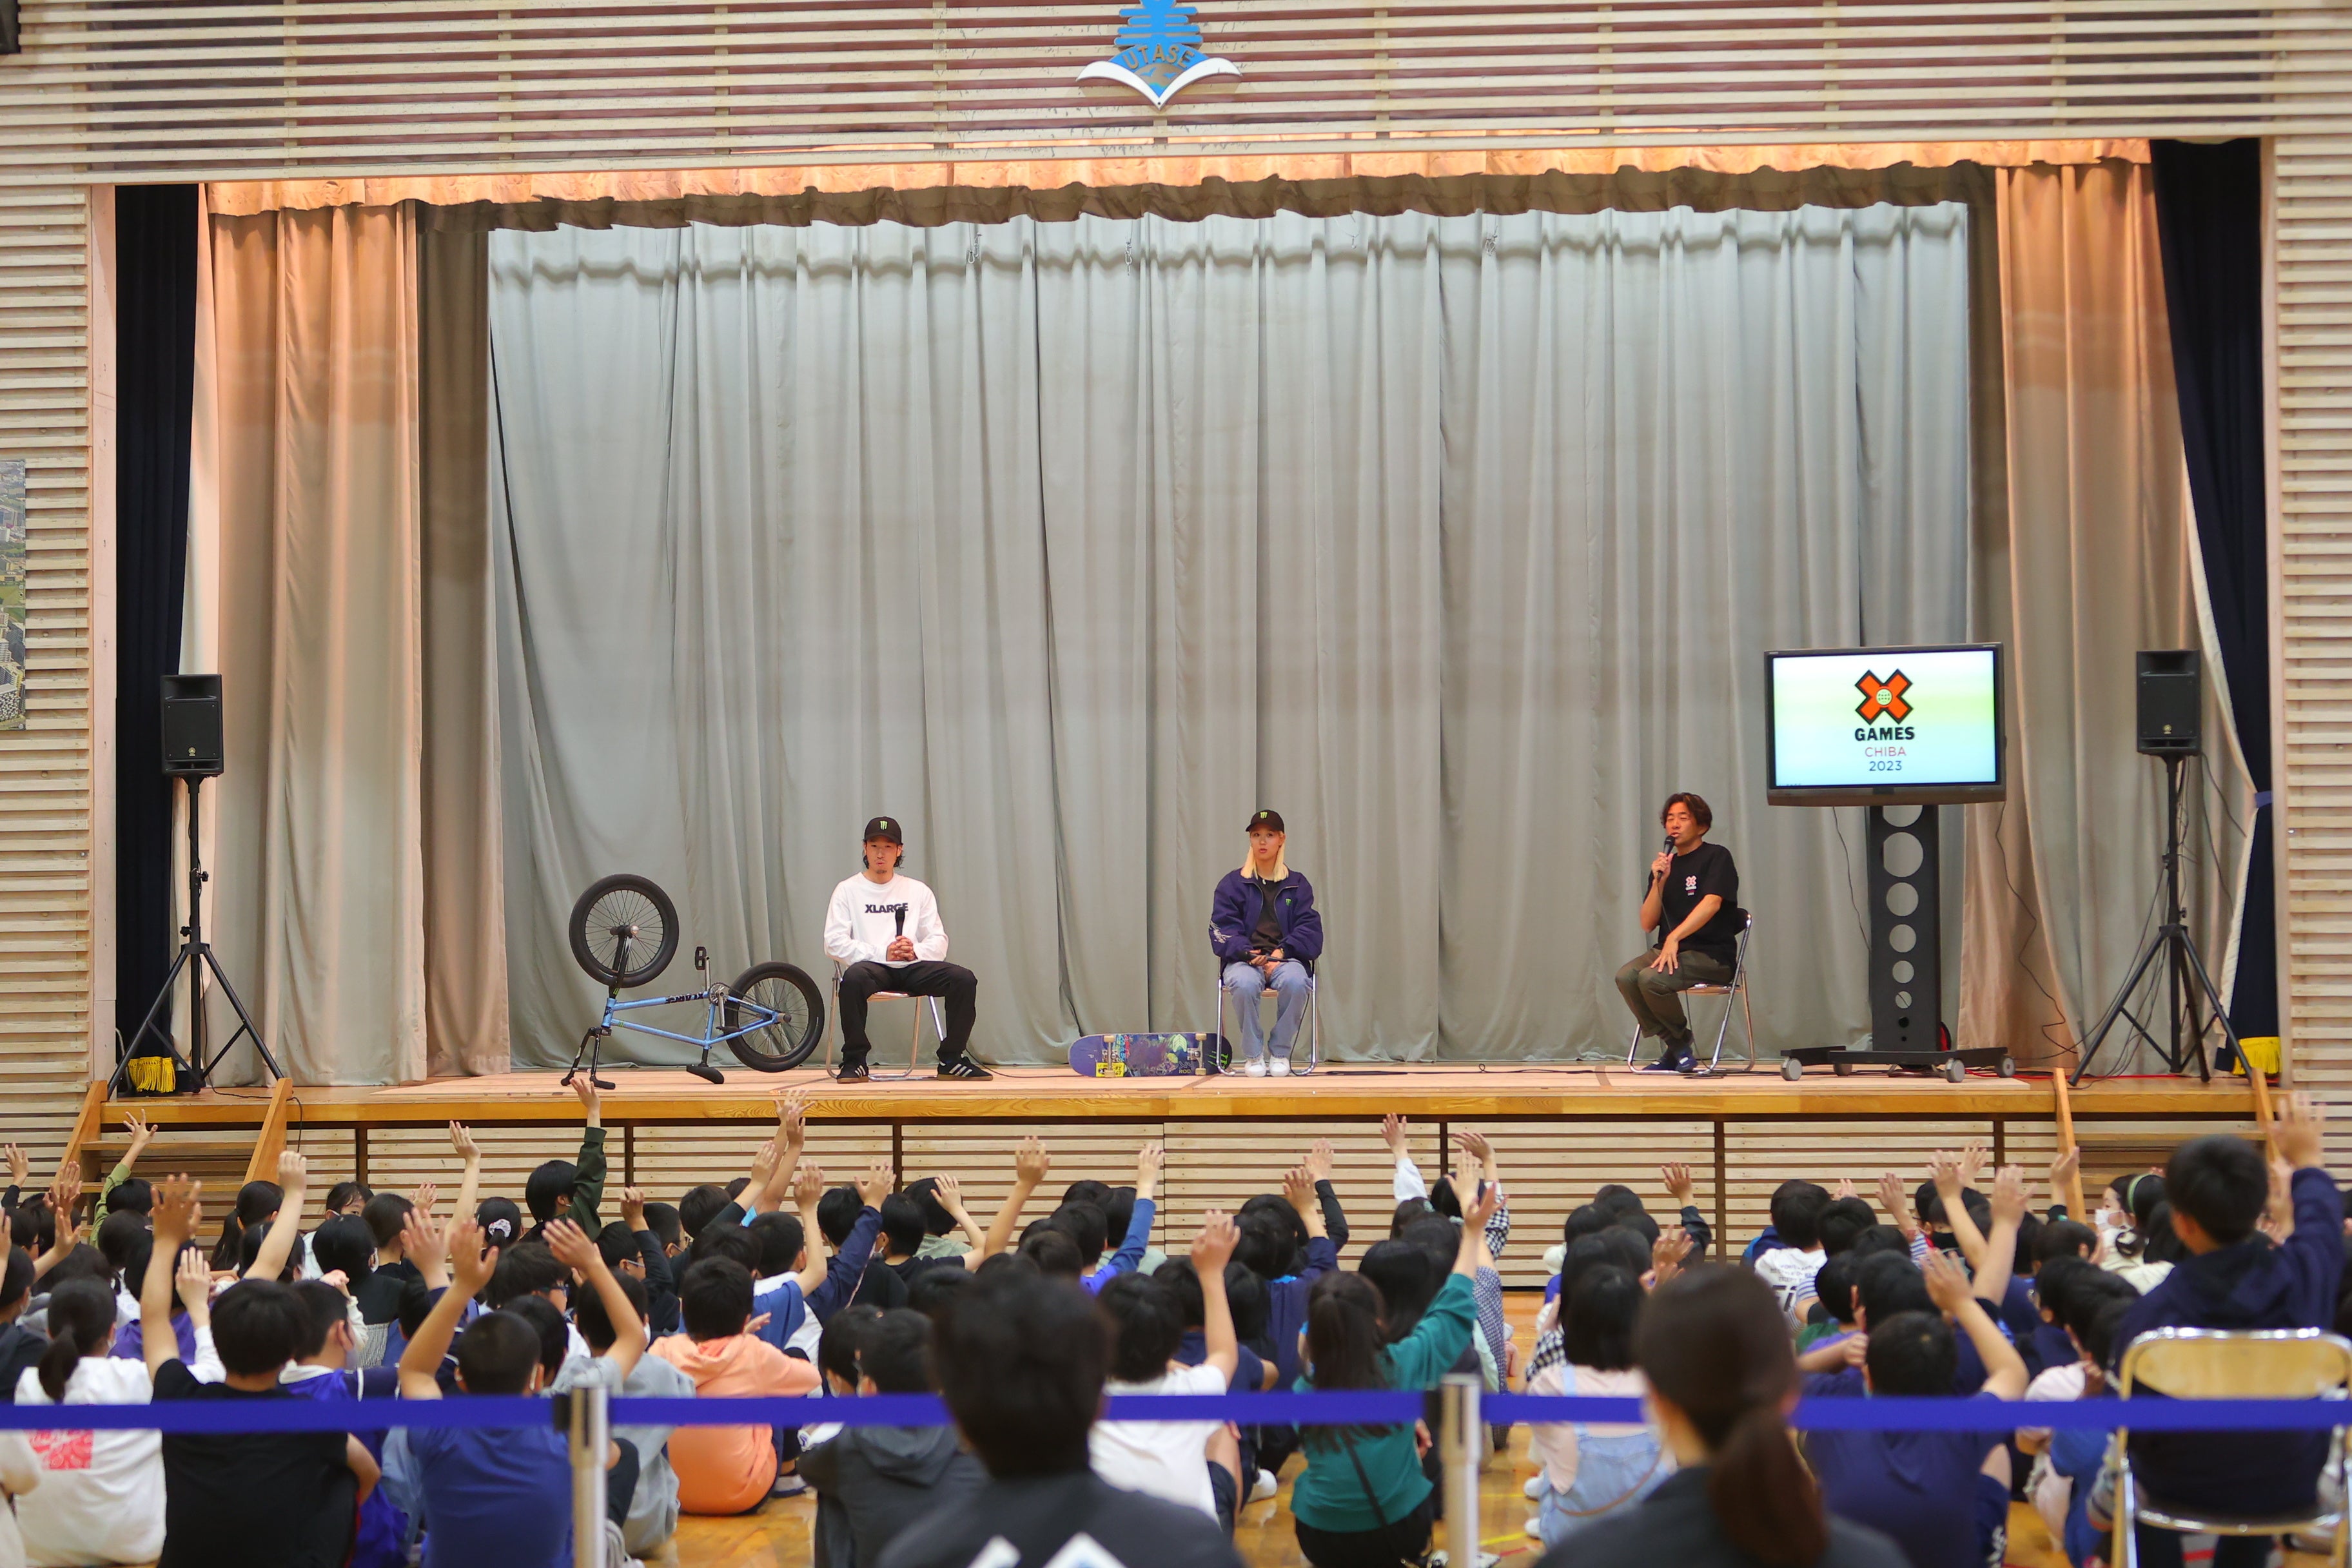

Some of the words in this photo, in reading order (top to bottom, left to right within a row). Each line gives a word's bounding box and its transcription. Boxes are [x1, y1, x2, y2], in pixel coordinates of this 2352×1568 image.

[1123, 44, 1195, 70] UTASE
[1854, 726, 1915, 741] GAMES
[1865, 746, 1906, 757] CHIBA
[1869, 760, 1902, 771] 2023
